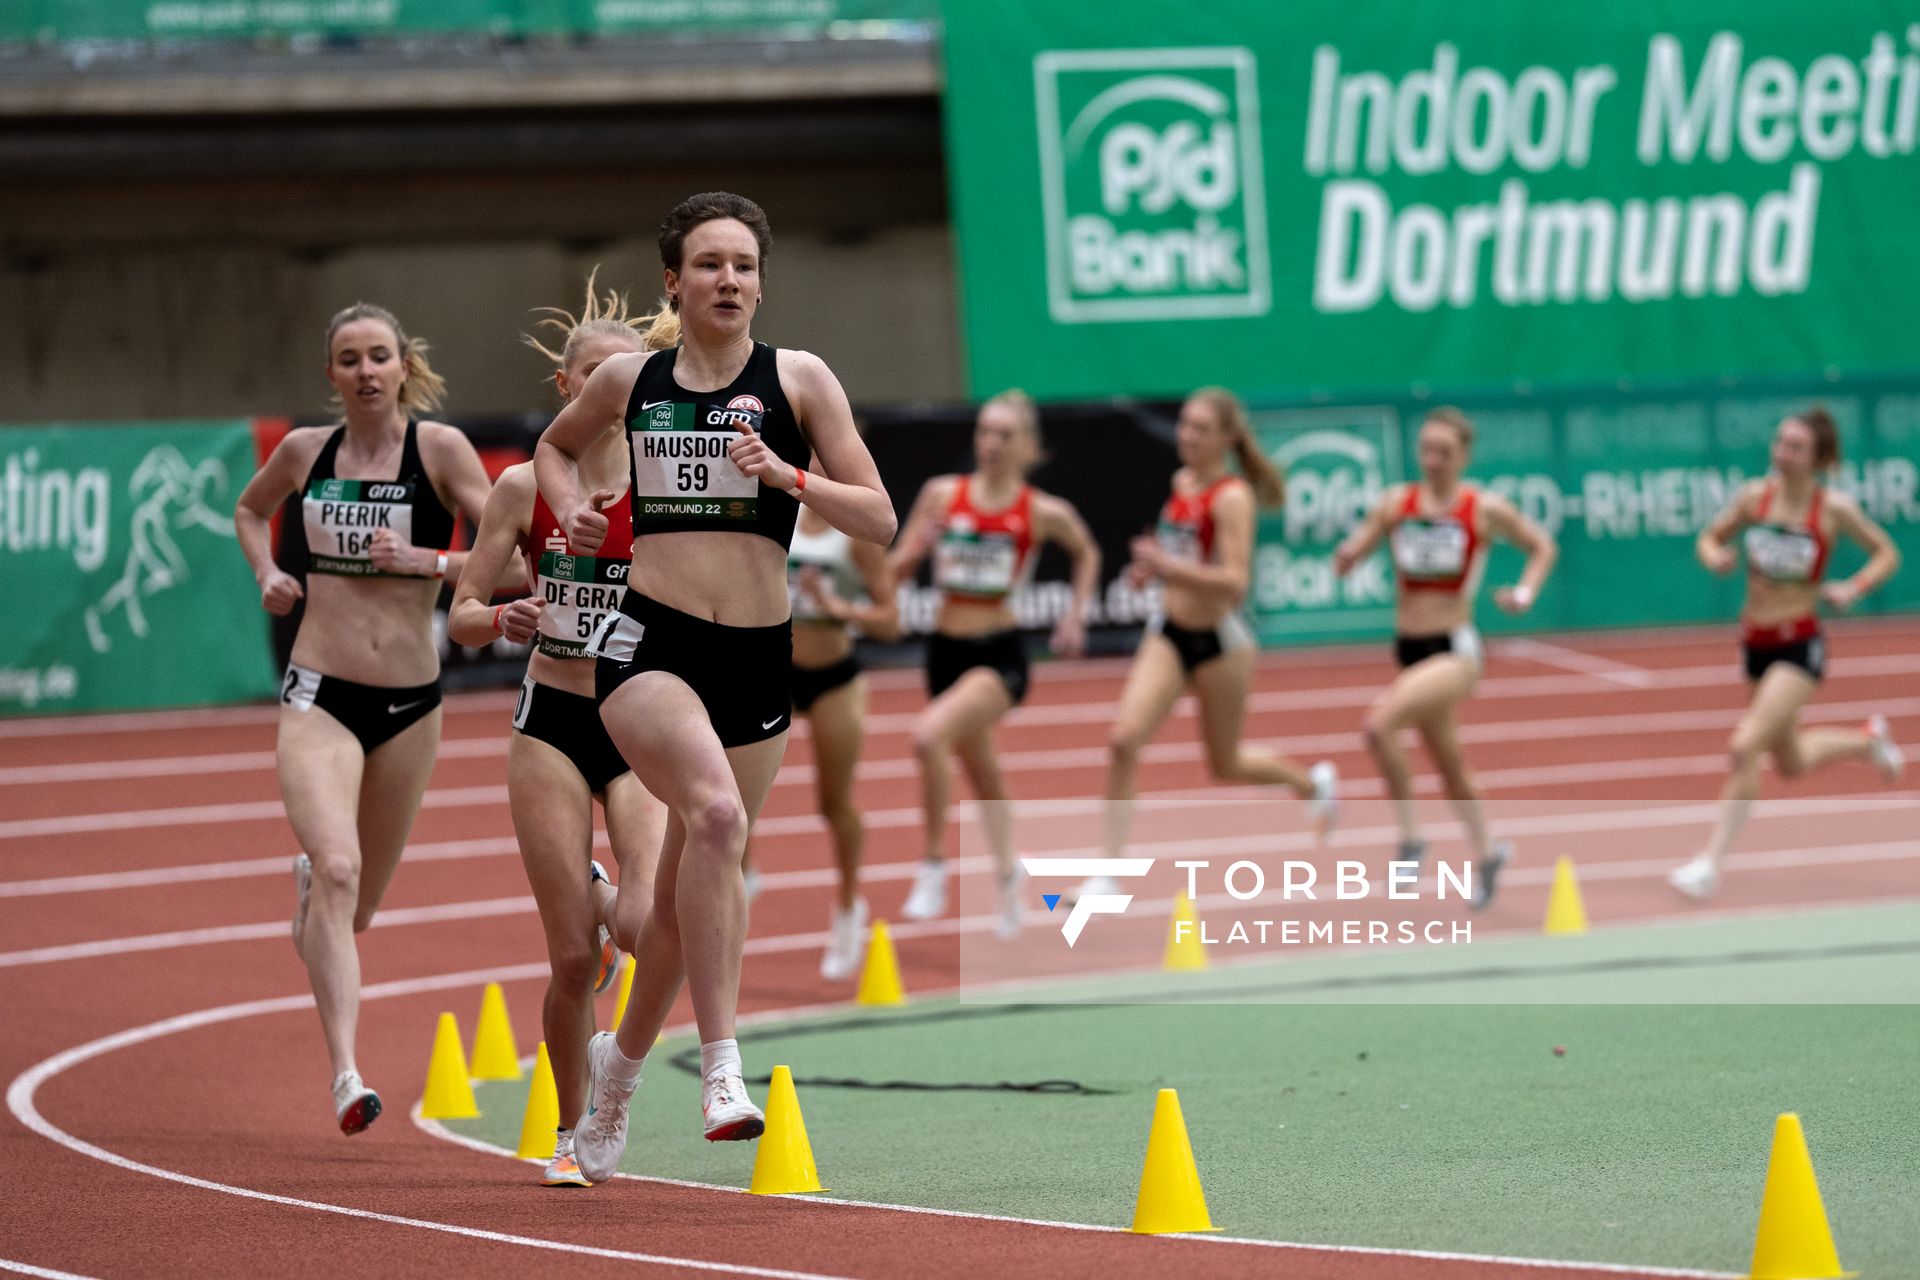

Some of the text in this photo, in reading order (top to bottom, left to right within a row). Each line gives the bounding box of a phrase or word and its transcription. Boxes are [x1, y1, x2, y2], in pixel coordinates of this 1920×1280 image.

[1303, 40, 1617, 177] Indoor
[1312, 160, 1822, 314] Dortmund
[1067, 213, 1247, 293] Bank
[652, 419, 671, 427] Bank
[677, 463, 709, 491] 59
[321, 503, 391, 528] PEERIK
[645, 503, 703, 514] DORTMUND
[705, 504, 721, 514] 22
[606, 564, 631, 579] Gf
[545, 581, 569, 607] DE
